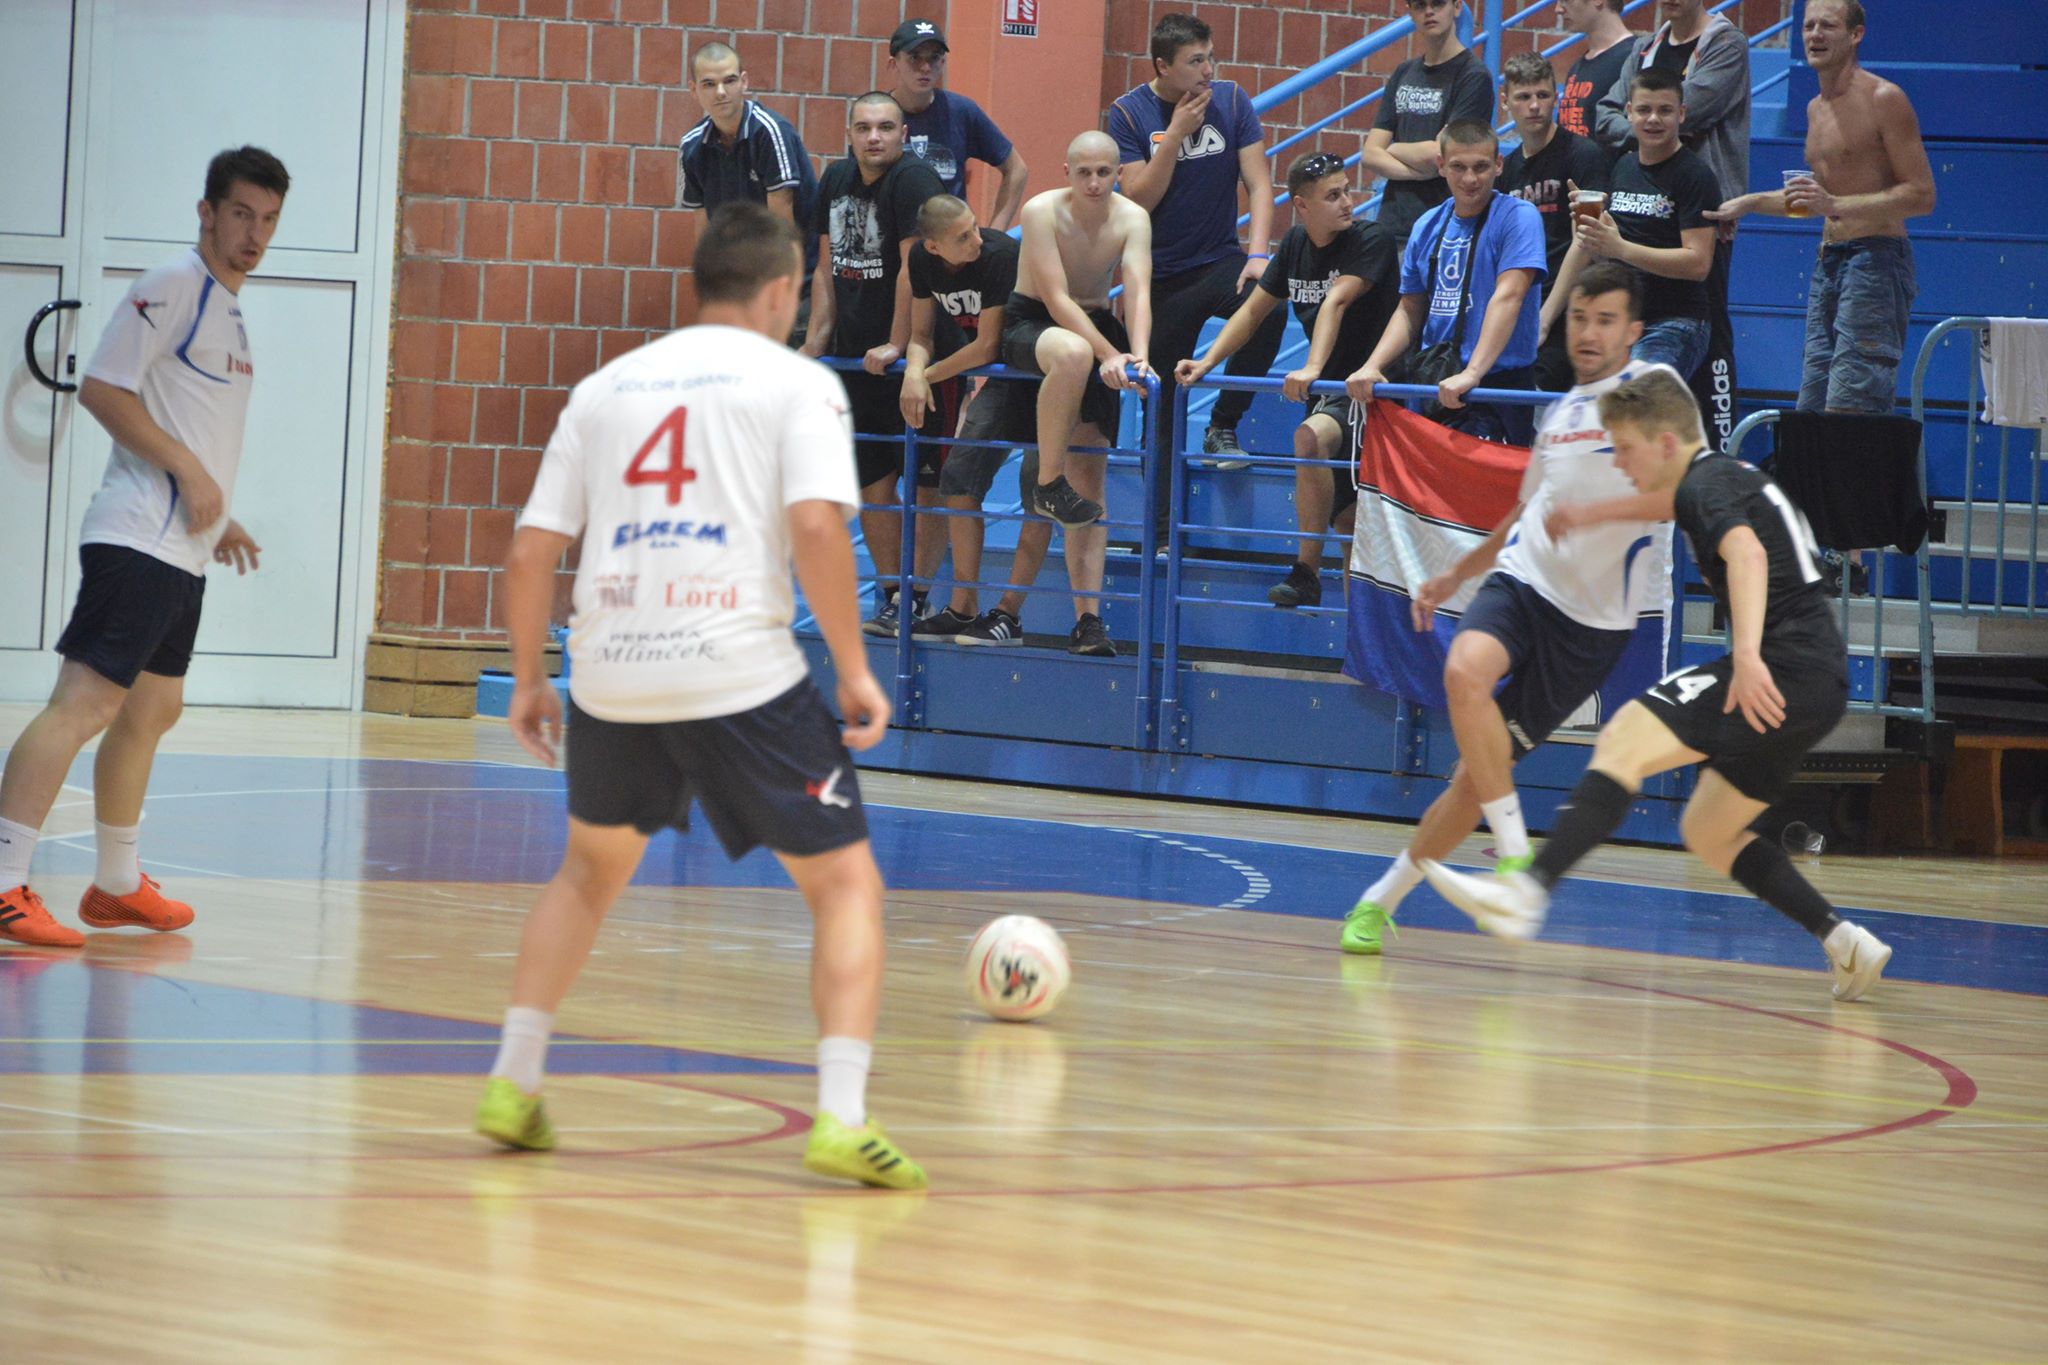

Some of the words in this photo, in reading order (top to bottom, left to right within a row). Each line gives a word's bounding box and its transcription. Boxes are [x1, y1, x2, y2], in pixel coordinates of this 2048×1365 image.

[1150, 124, 1226, 161] LA
[1711, 358, 1732, 455] adidas
[623, 405, 697, 508] 4
[664, 581, 738, 610] Lord
